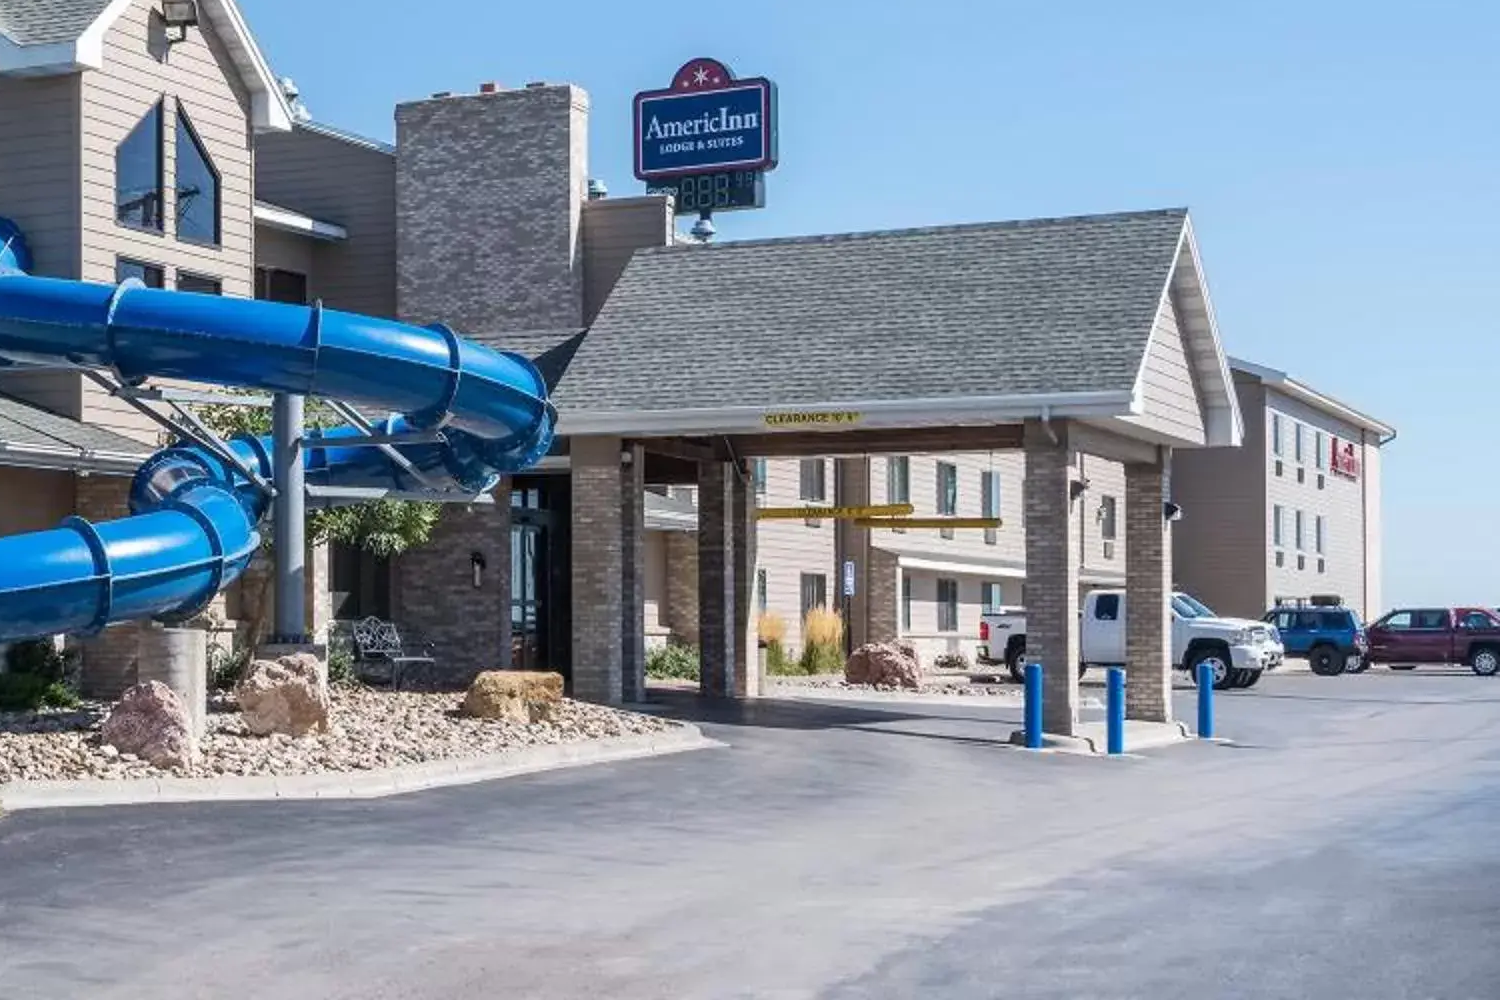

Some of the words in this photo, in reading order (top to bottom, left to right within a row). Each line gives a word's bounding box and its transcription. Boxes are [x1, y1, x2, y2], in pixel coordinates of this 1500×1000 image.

[645, 106, 759, 139] AmericInn
[659, 140, 695, 154] LODGE
[707, 135, 744, 149] SUITES
[765, 412, 829, 425] CLEARANCE
